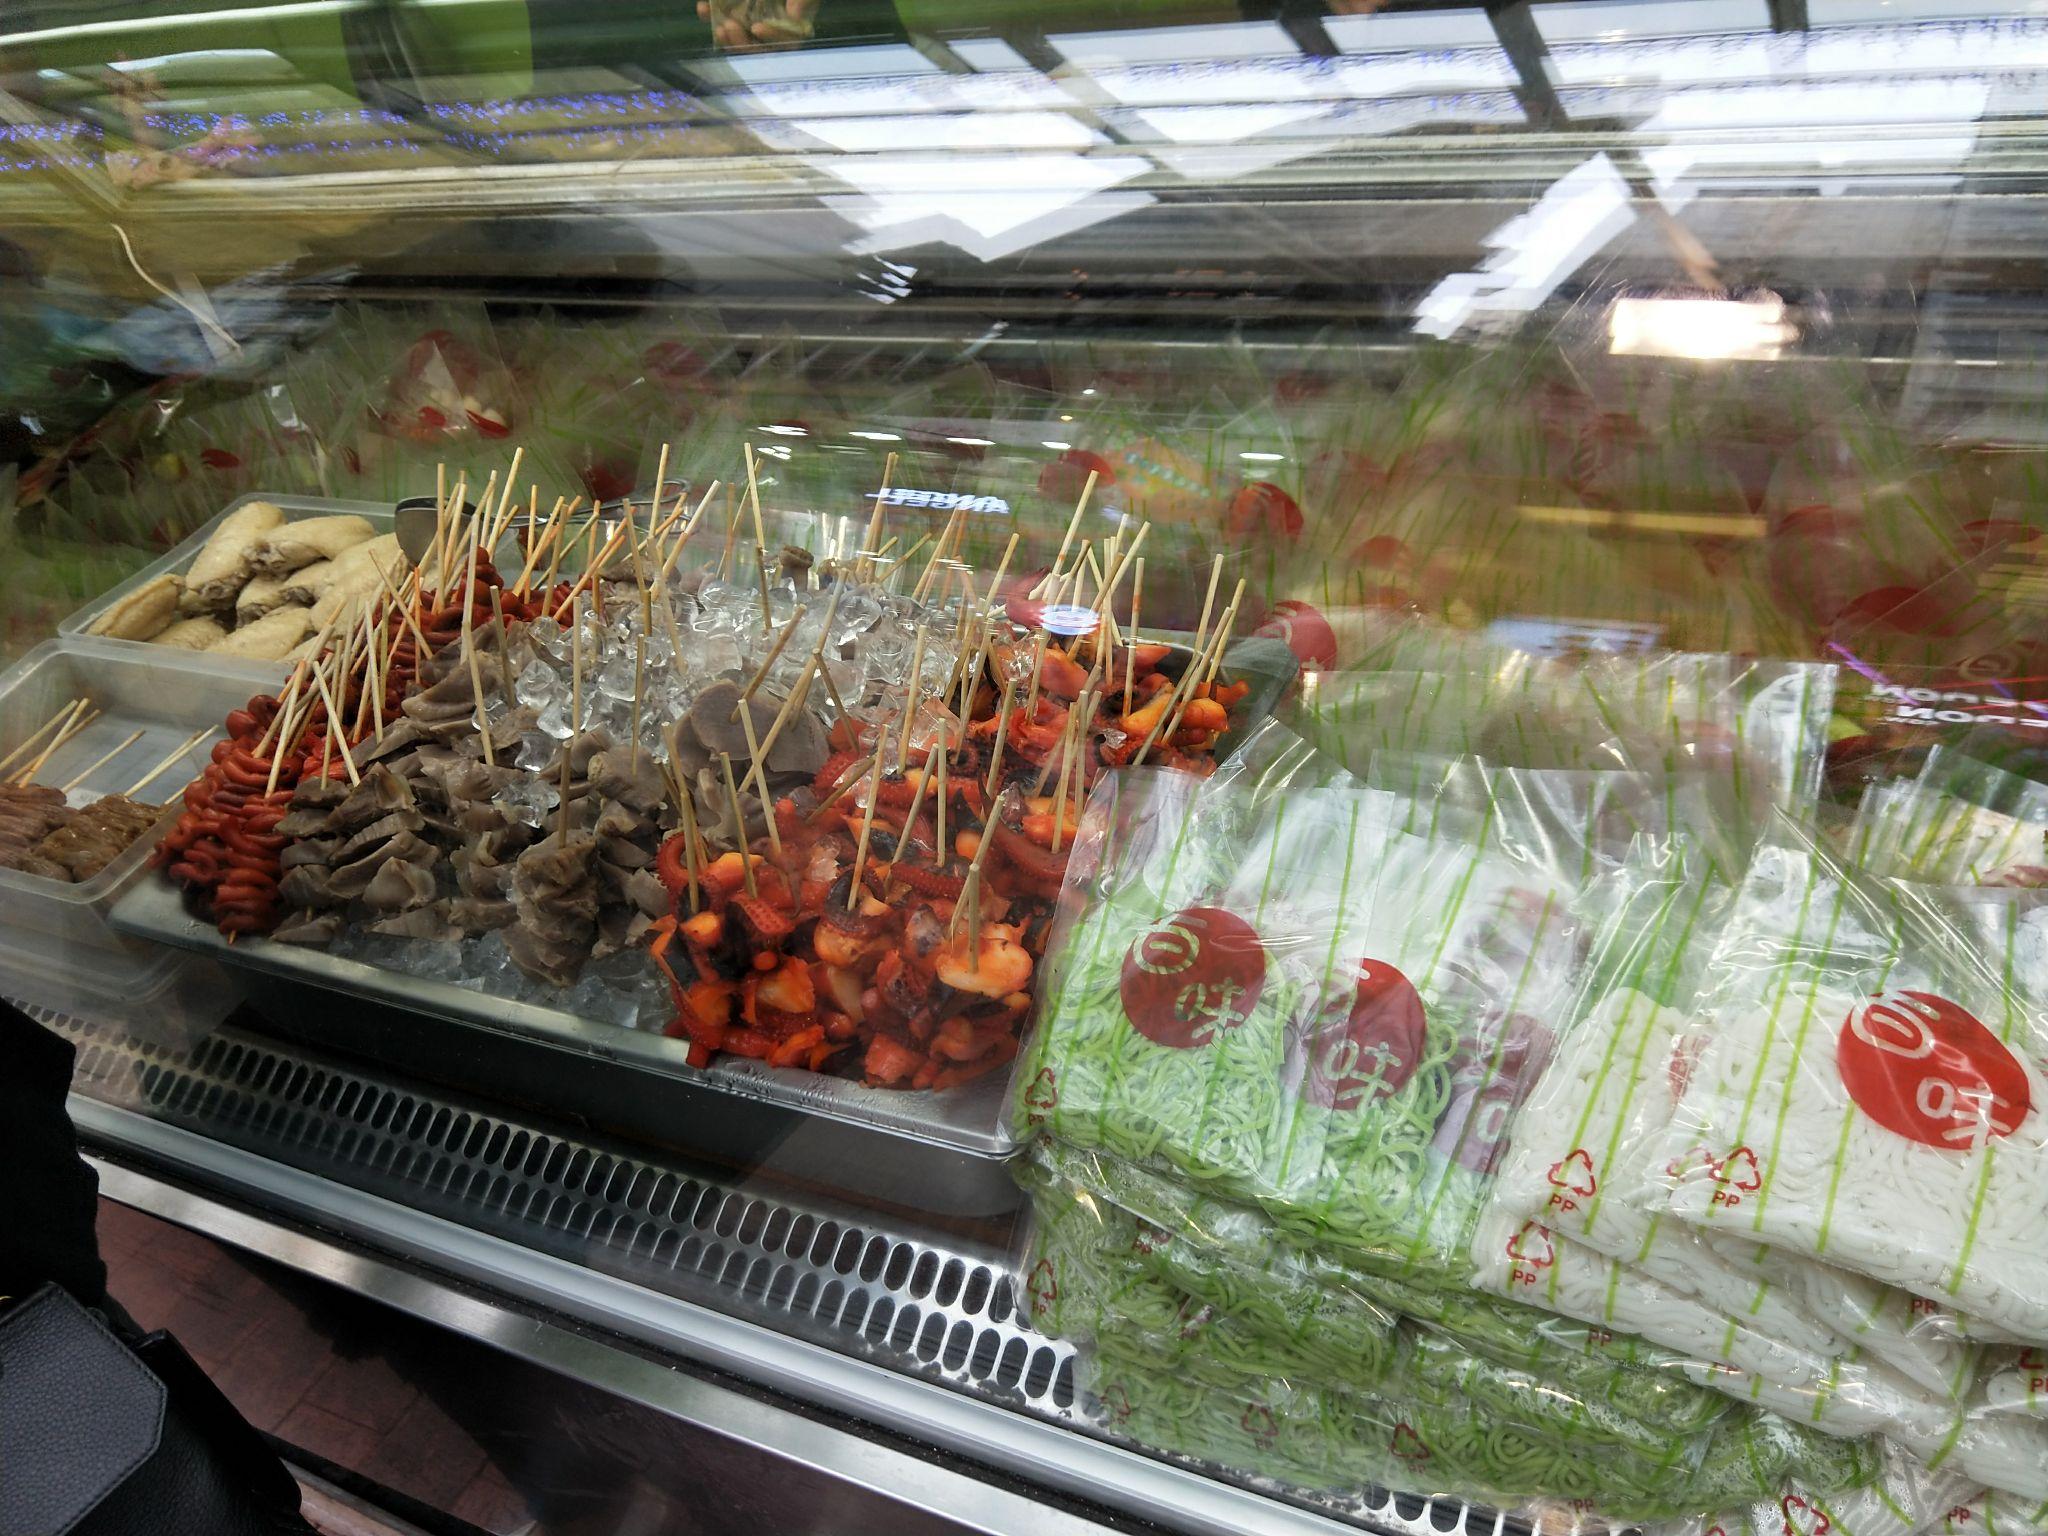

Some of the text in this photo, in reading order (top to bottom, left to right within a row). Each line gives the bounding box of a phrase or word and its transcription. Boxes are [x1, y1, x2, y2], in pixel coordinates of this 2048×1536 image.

[1028, 1113, 1045, 1126] PP
[1549, 1193, 1574, 1212] PP
[1712, 1189, 1740, 1208] PP
[1513, 1268, 1537, 1286] PP
[1588, 1327, 1612, 1346] PP
[2031, 1377, 2048, 1393] P
[1947, 1505, 1971, 1525] PP
